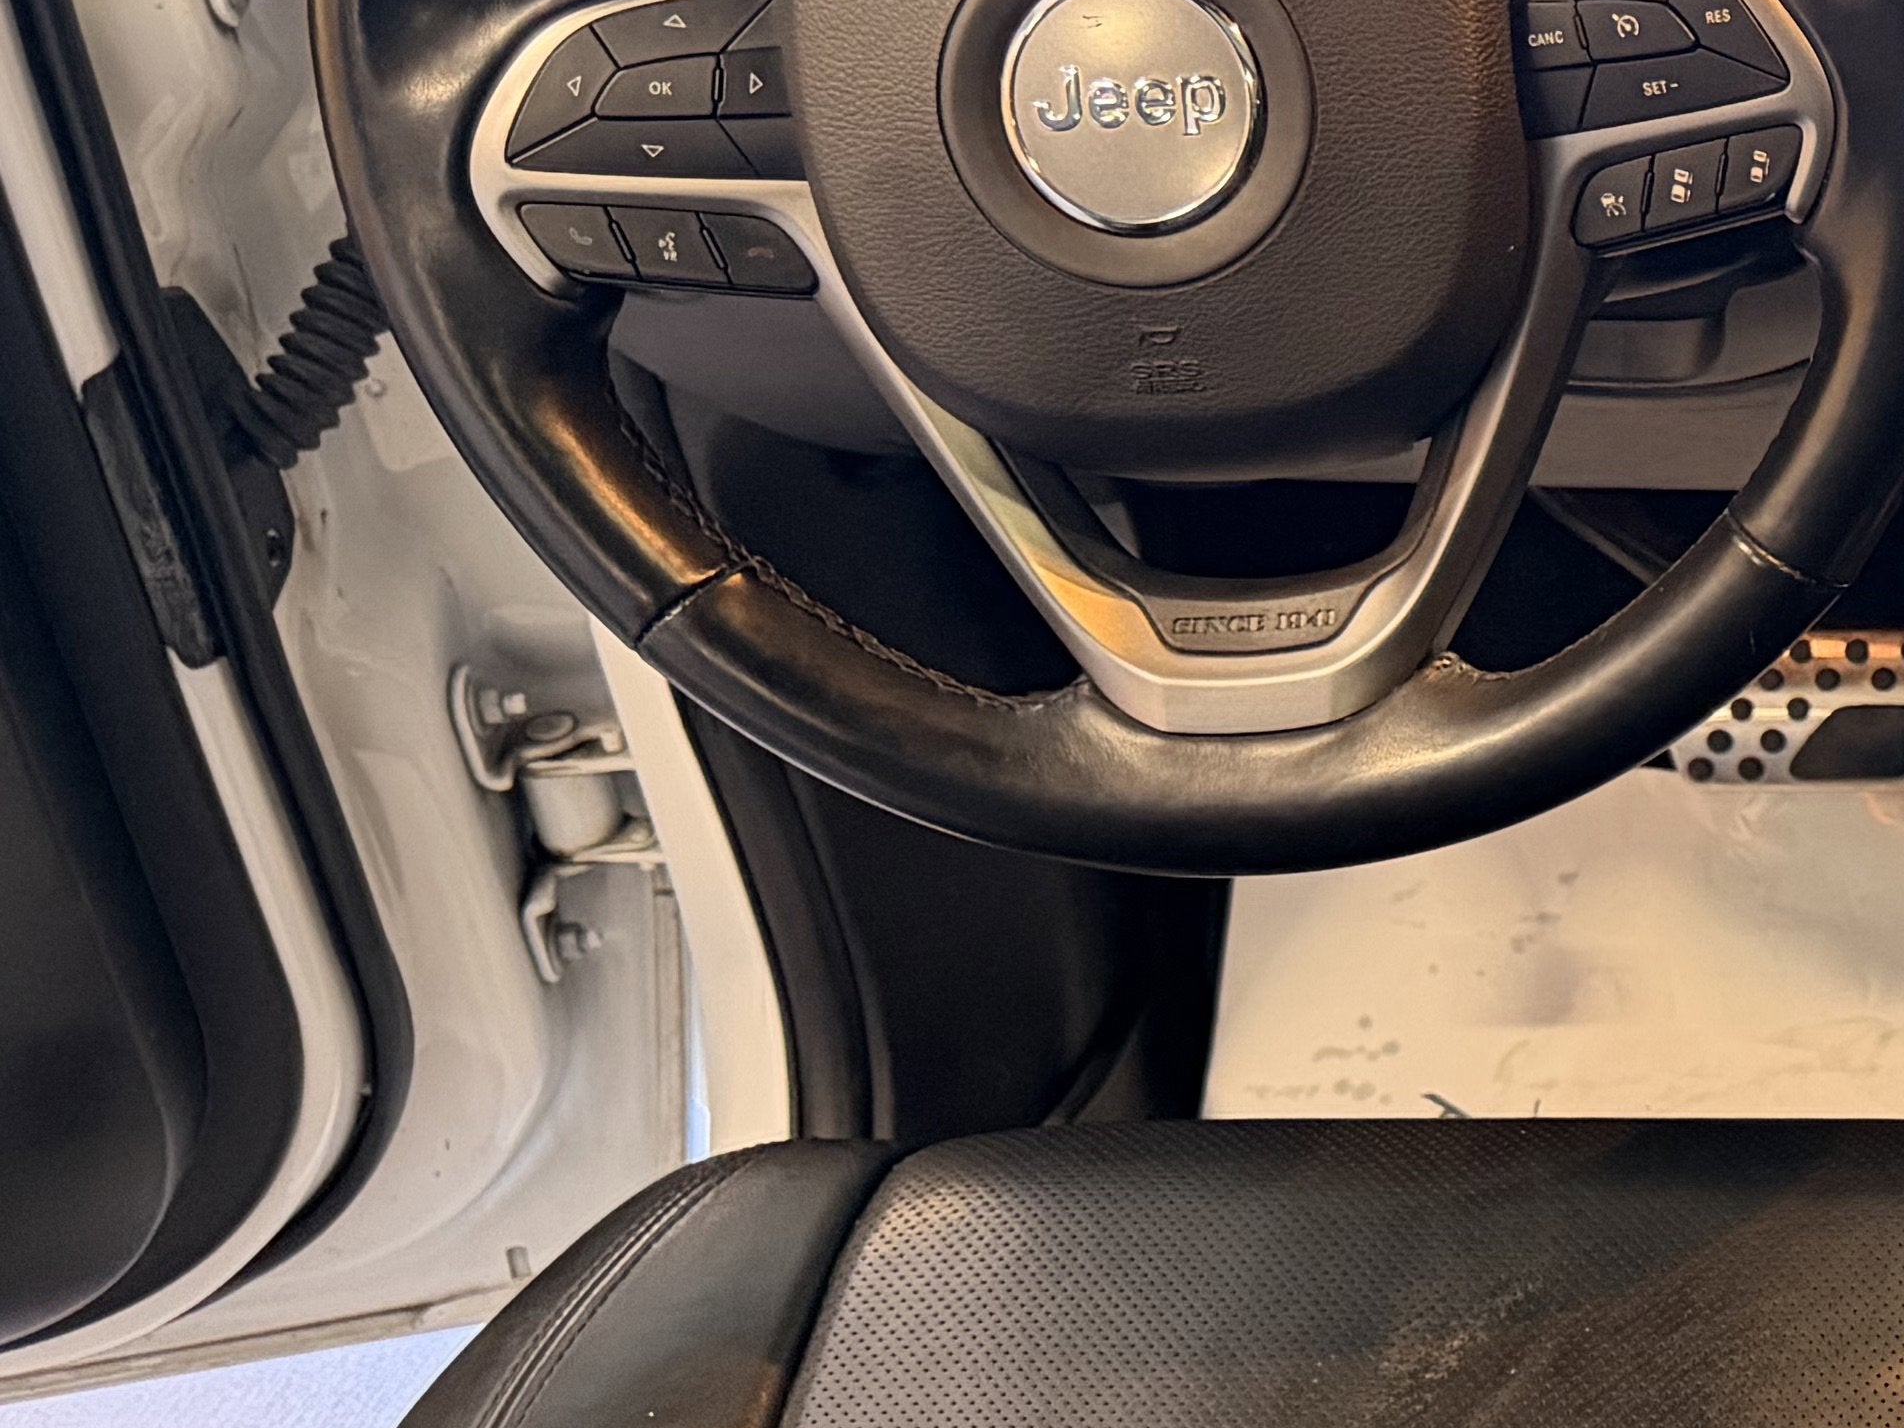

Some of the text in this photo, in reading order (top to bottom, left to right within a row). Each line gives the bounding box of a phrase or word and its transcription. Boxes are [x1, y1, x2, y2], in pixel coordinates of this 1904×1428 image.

[1705, 8, 1732, 24] RES
[1528, 31, 1564, 48] CANC
[649, 81, 673, 96] OK
[1032, 63, 1227, 137] Jeep
[1172, 608, 1336, 634] SINCE 1941
